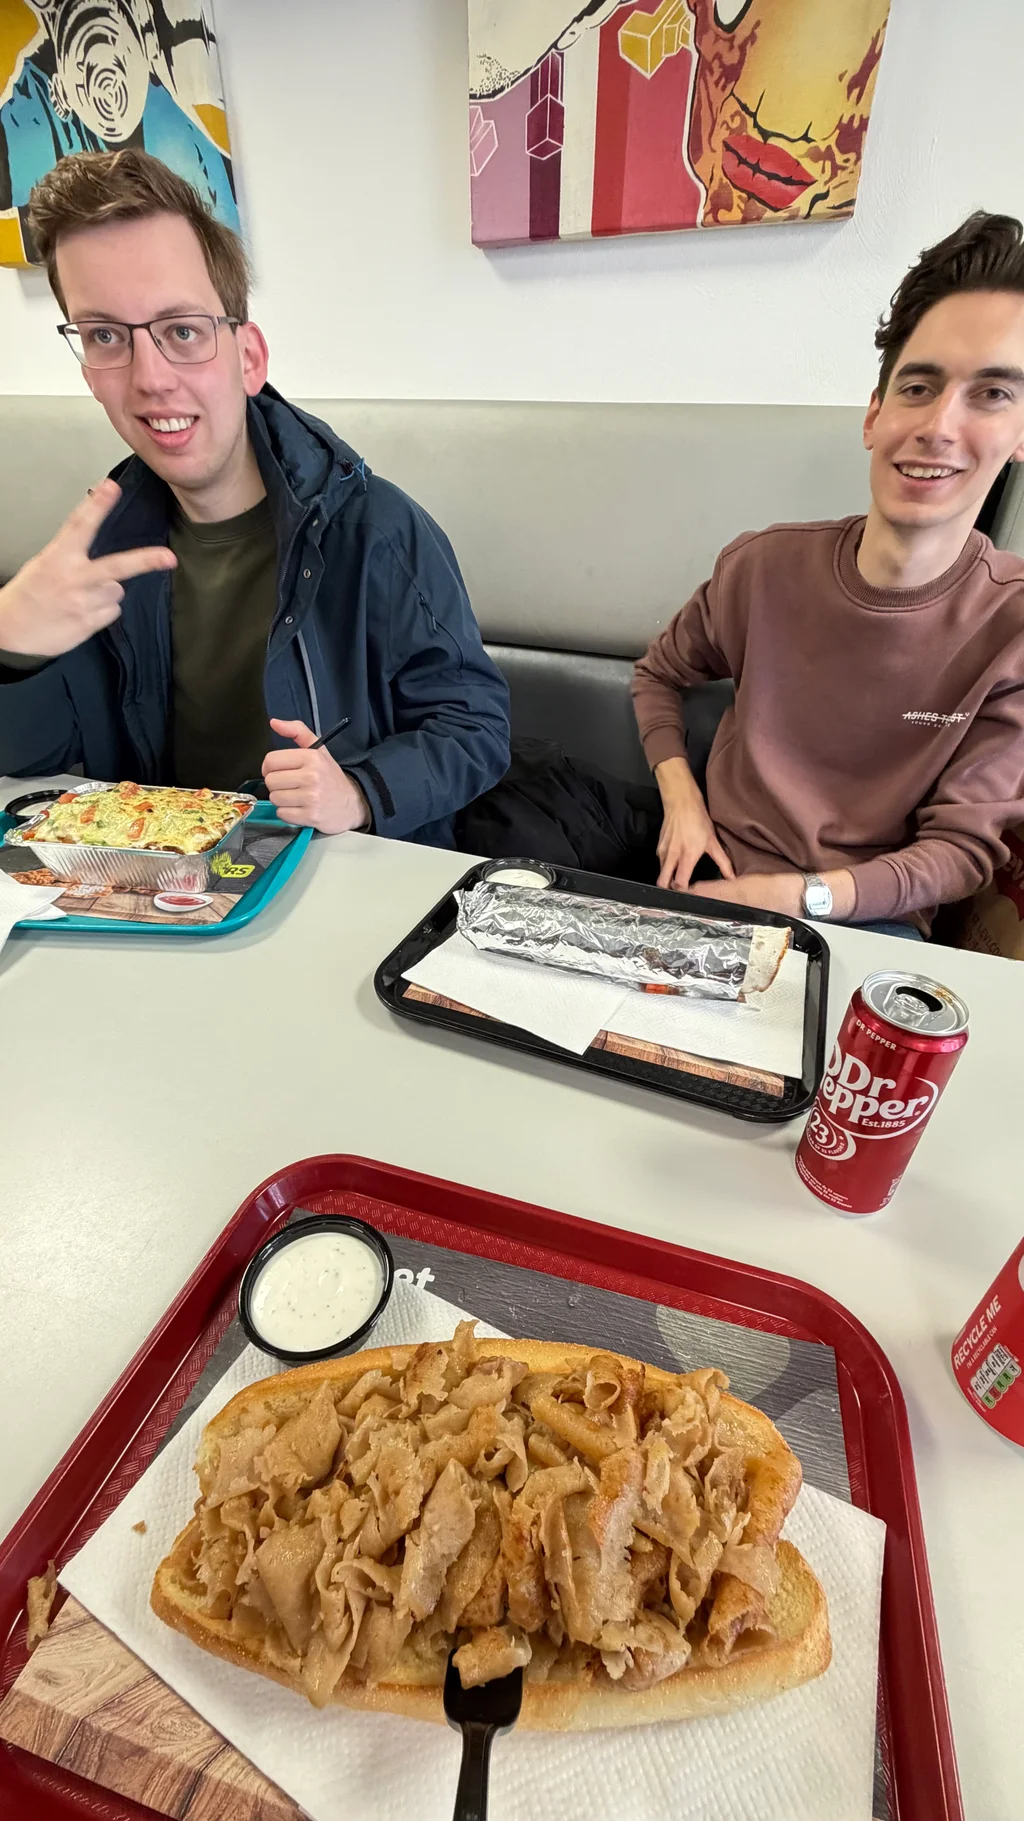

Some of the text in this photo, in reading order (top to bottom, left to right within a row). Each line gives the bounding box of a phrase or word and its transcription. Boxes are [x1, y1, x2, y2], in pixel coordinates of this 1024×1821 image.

[903, 711, 939, 722] ASHES
[976, 922, 1002, 952] LEVI.CO
[856, 1019, 897, 1051] DR PEPPER
[836, 1052, 897, 1098] Dr
[810, 1111, 829, 1144] 23
[953, 1314, 988, 1370] RECYCLE
[985, 1294, 1002, 1323] ME
